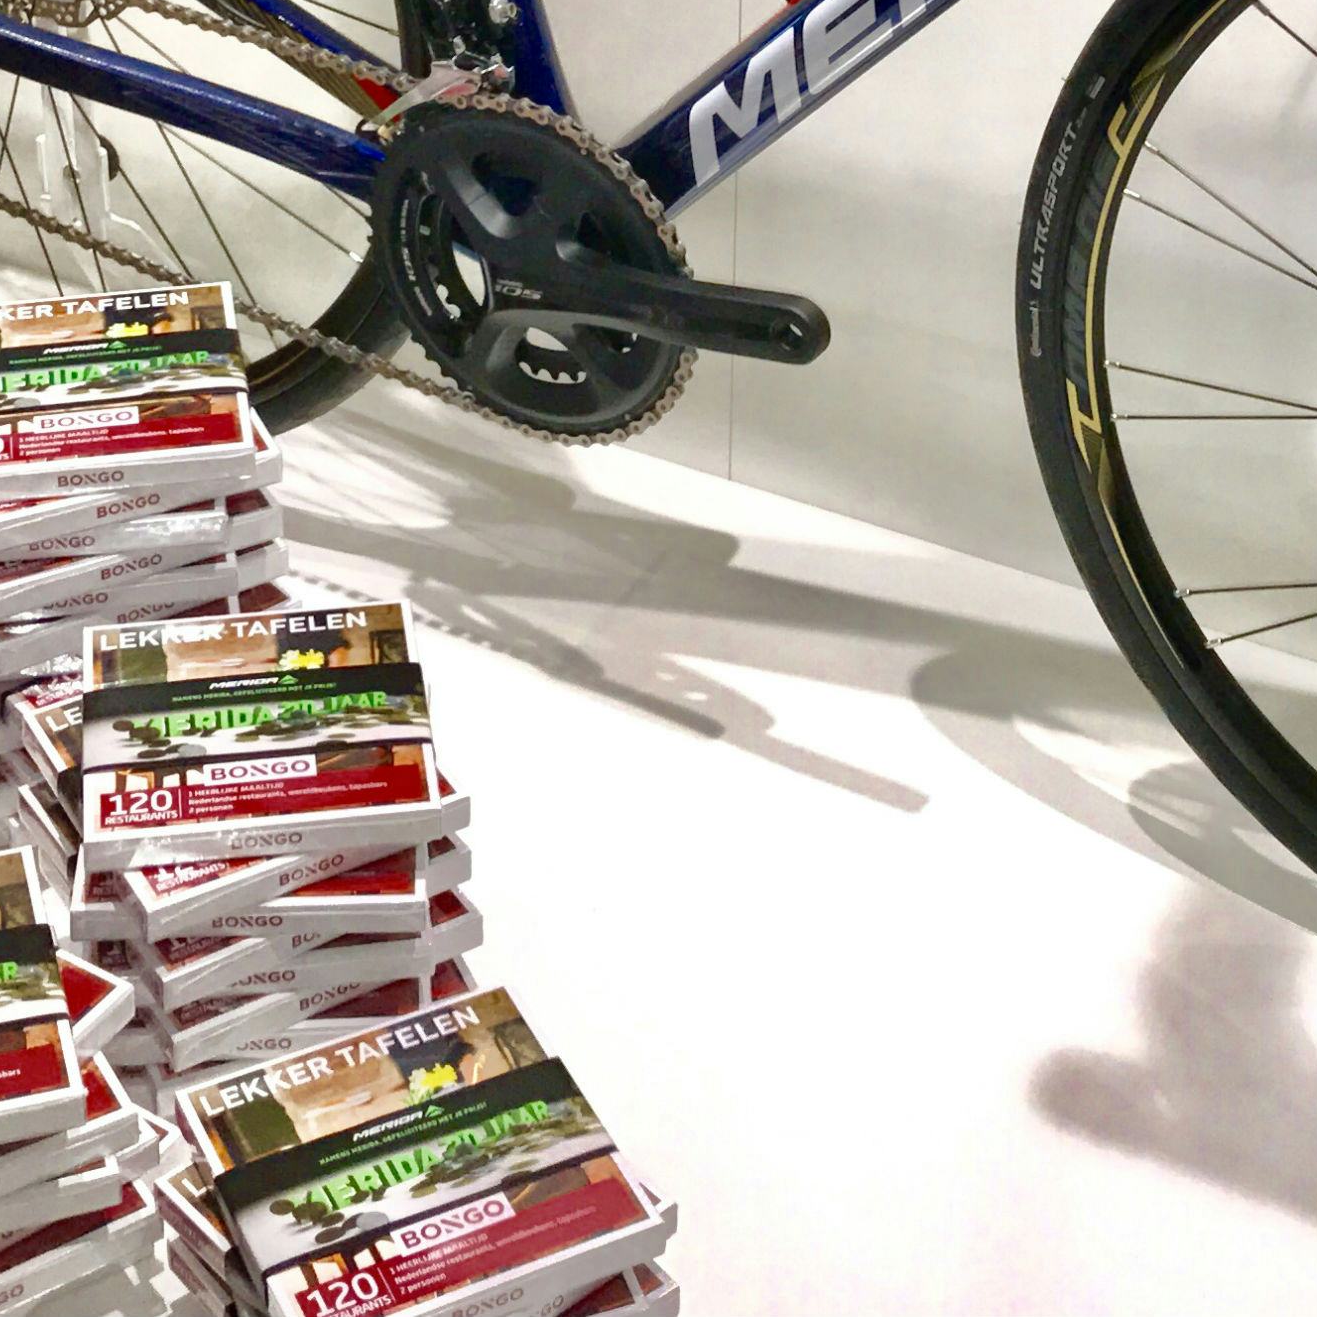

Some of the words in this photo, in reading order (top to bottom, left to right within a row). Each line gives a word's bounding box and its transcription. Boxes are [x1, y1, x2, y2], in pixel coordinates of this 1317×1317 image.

[1030, 121, 1078, 290] ULTRASPORT
[62, 290, 190, 315] TAFELEN
[41, 411, 133, 430] BONGO
[58, 470, 125, 488] BONGO
[96, 493, 161, 519] BONGO
[29, 535, 96, 551] BONGO
[100, 553, 163, 580] BONGO
[43, 592, 109, 610] NGO
[231, 611, 367, 639] TAFELEN
[209, 676, 280, 690] MERIDA
[211, 760, 311, 781] BONGO
[108, 789, 173, 816] 120
[105, 810, 179, 826] RESTAURANTS
[279, 853, 345, 887] BONGO
[212, 914, 283, 930] BONGO
[232, 969, 296, 988] NGO
[237, 1037, 293, 1052] NGO
[199, 1056, 335, 1118] LEKKER
[337, 1006, 482, 1070] TAFELEN
[353, 1110, 424, 1142] MERIDA
[400, 1199, 505, 1250] BONGO
[307, 1272, 379, 1317] 120
[452, 1287, 524, 1317] BONGO
